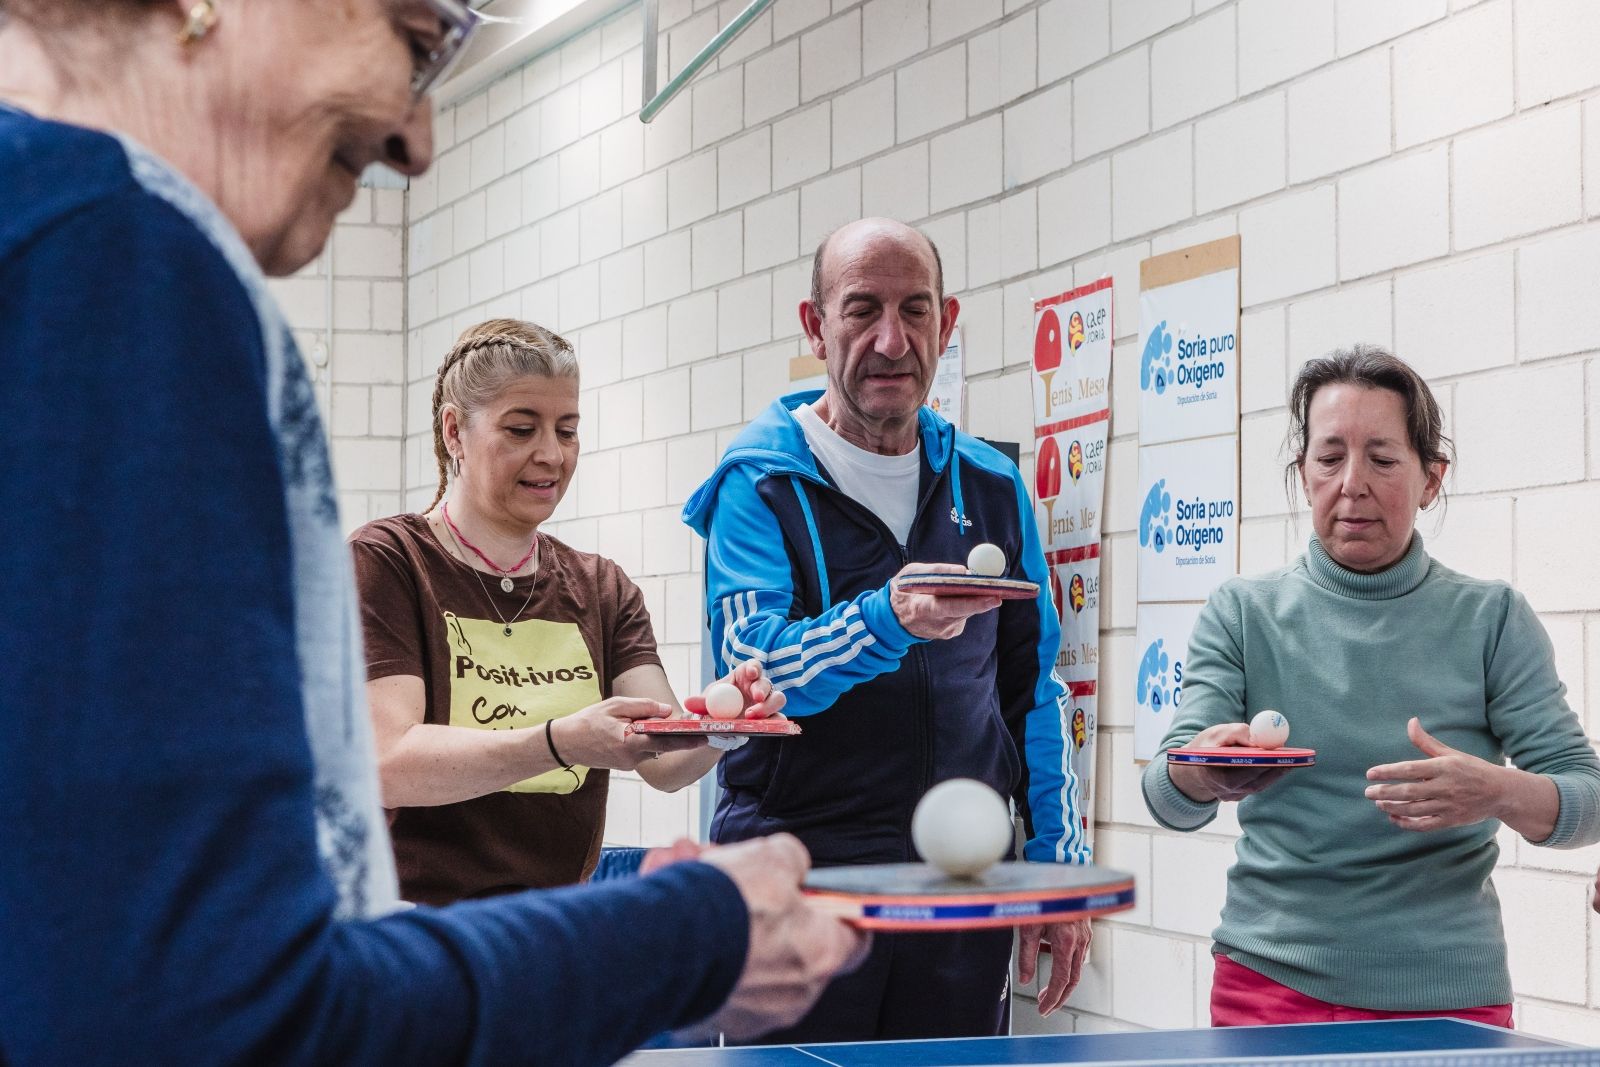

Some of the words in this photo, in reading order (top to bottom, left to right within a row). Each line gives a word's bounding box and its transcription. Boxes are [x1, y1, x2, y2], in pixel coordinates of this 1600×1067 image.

[1177, 334, 1207, 360] Soria
[1209, 334, 1235, 361] puro
[1077, 377, 1105, 400] Mesa
[1177, 361, 1224, 388] Oxígeno
[1176, 497, 1206, 521] Soria
[1208, 500, 1233, 525] puro
[1176, 523, 1224, 551] Oxígeno
[456, 655, 593, 688] Posit-ivos
[472, 696, 526, 724] Con
